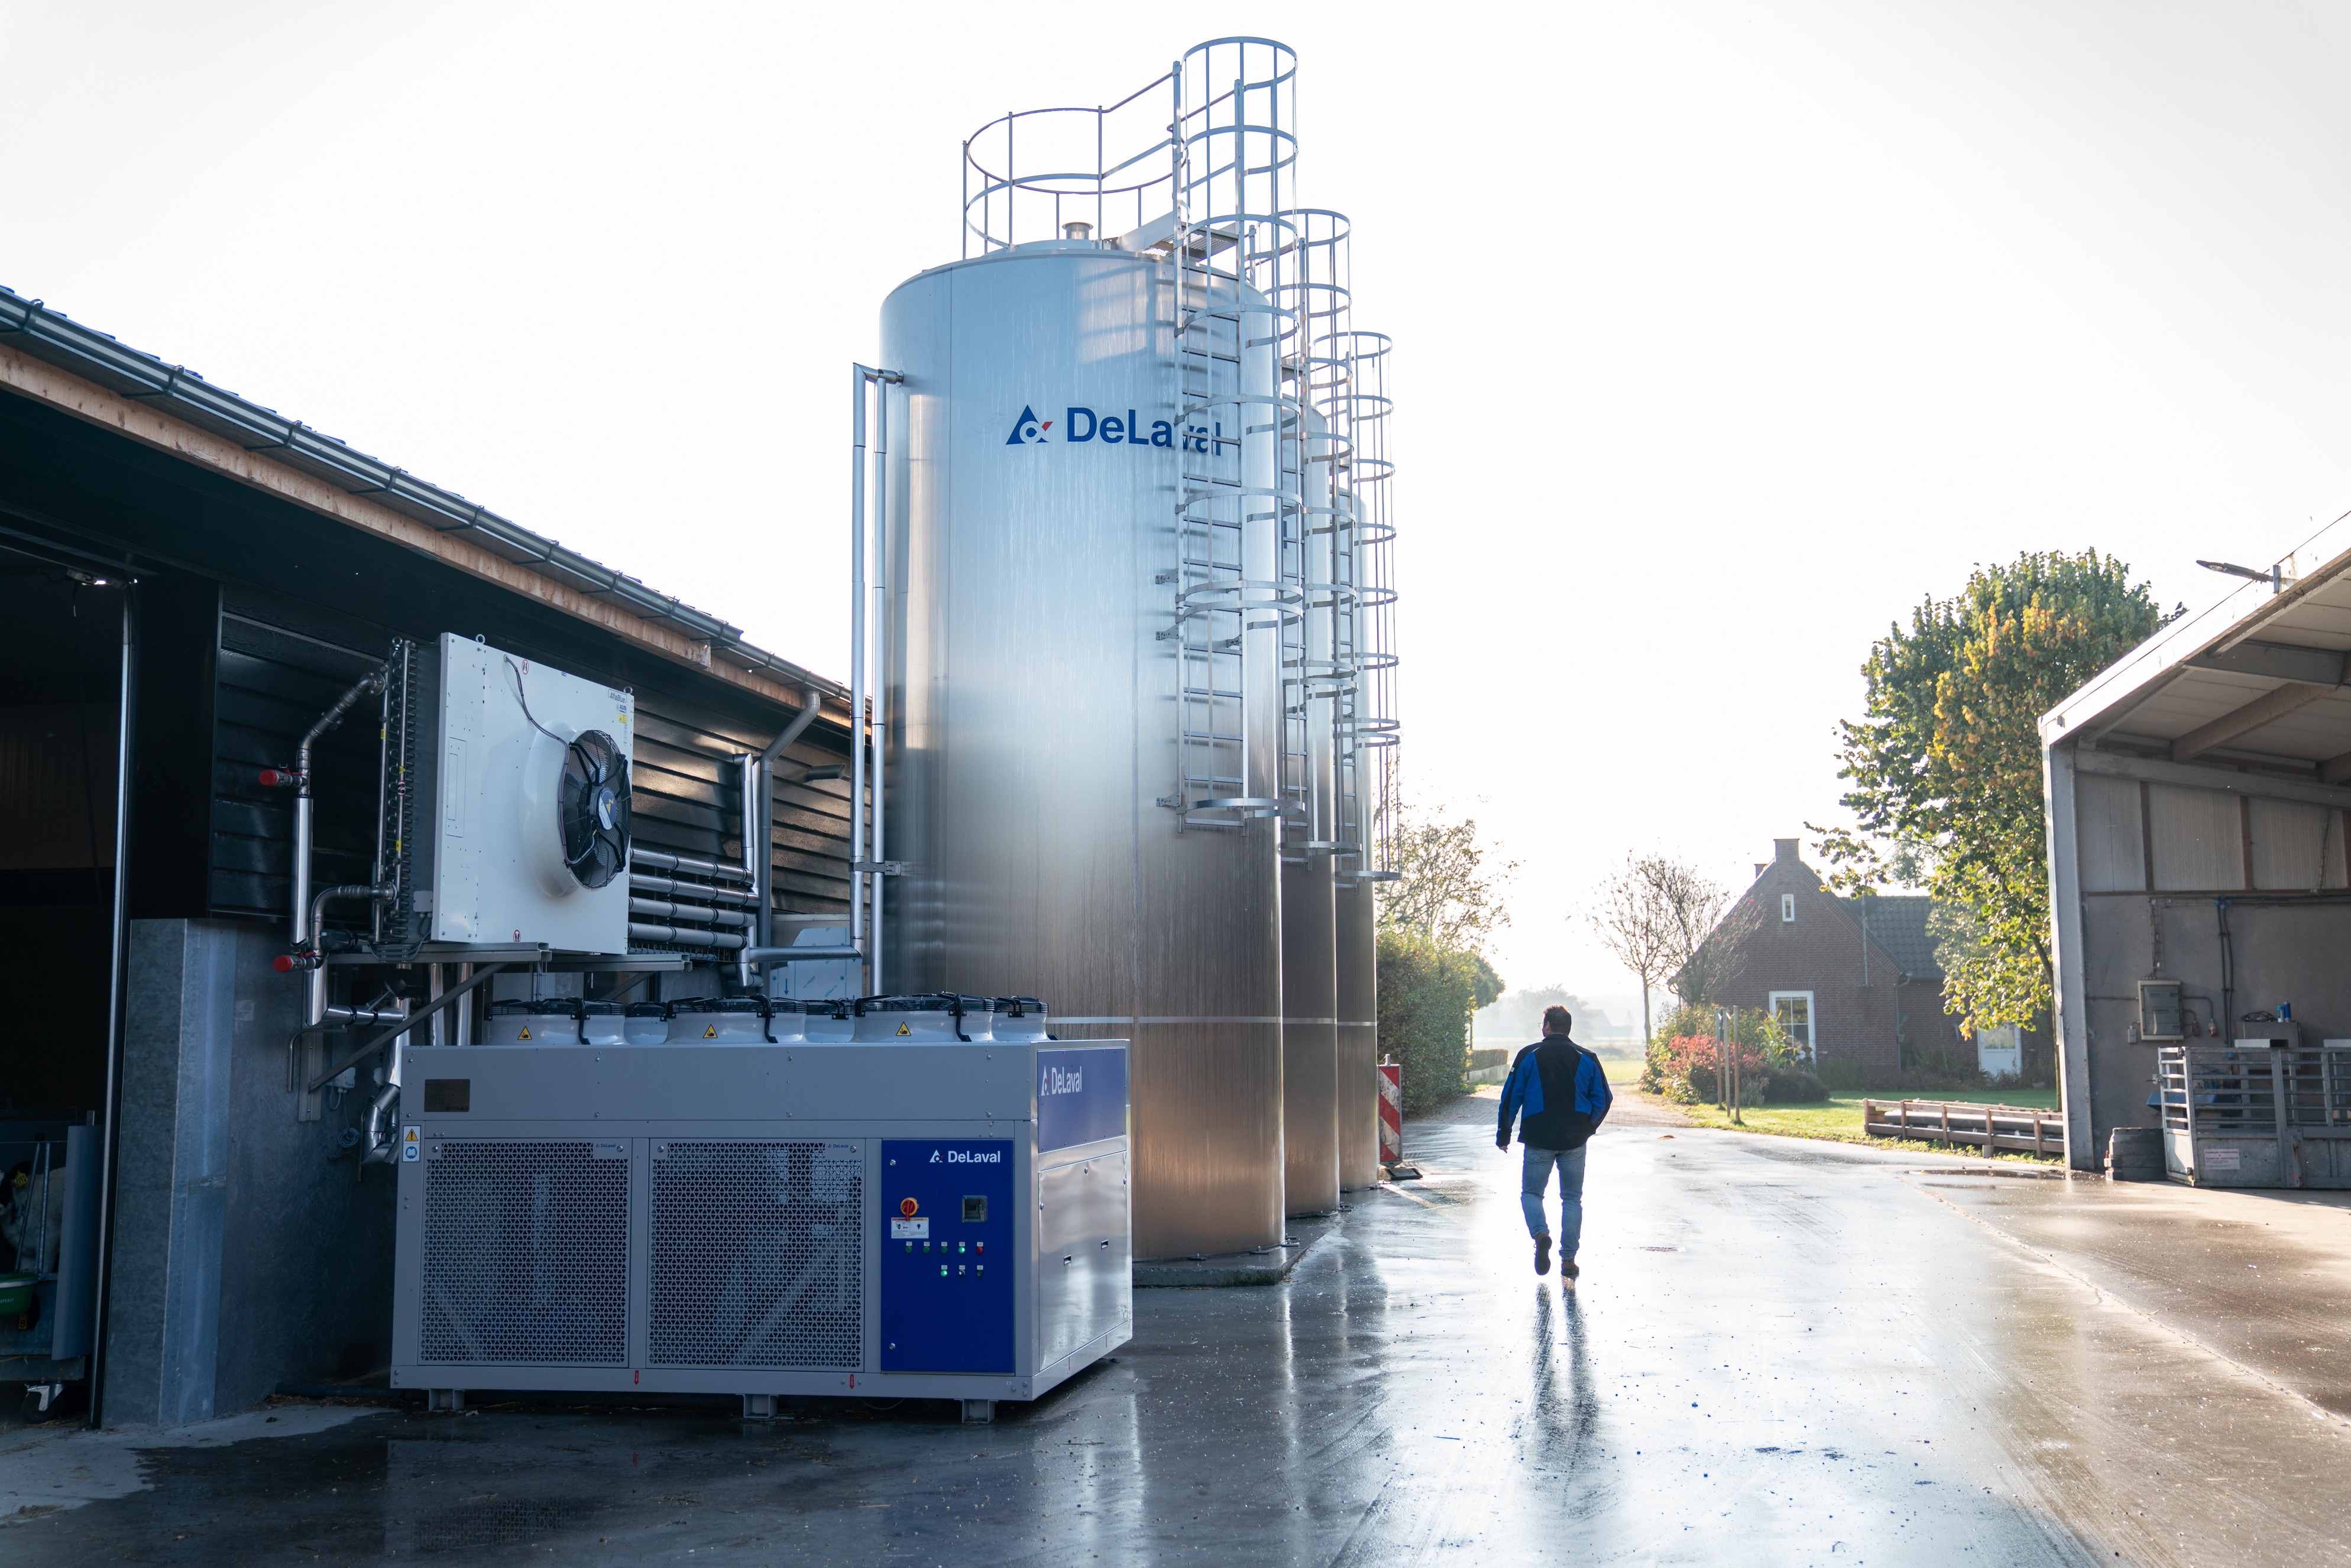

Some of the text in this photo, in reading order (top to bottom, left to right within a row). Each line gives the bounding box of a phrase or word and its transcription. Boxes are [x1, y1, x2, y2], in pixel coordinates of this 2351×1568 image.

[610, 692, 626, 703] AlfaBlue
[1052, 1066, 1081, 1094] DeLaval
[948, 1151, 1000, 1162] DeLaval
